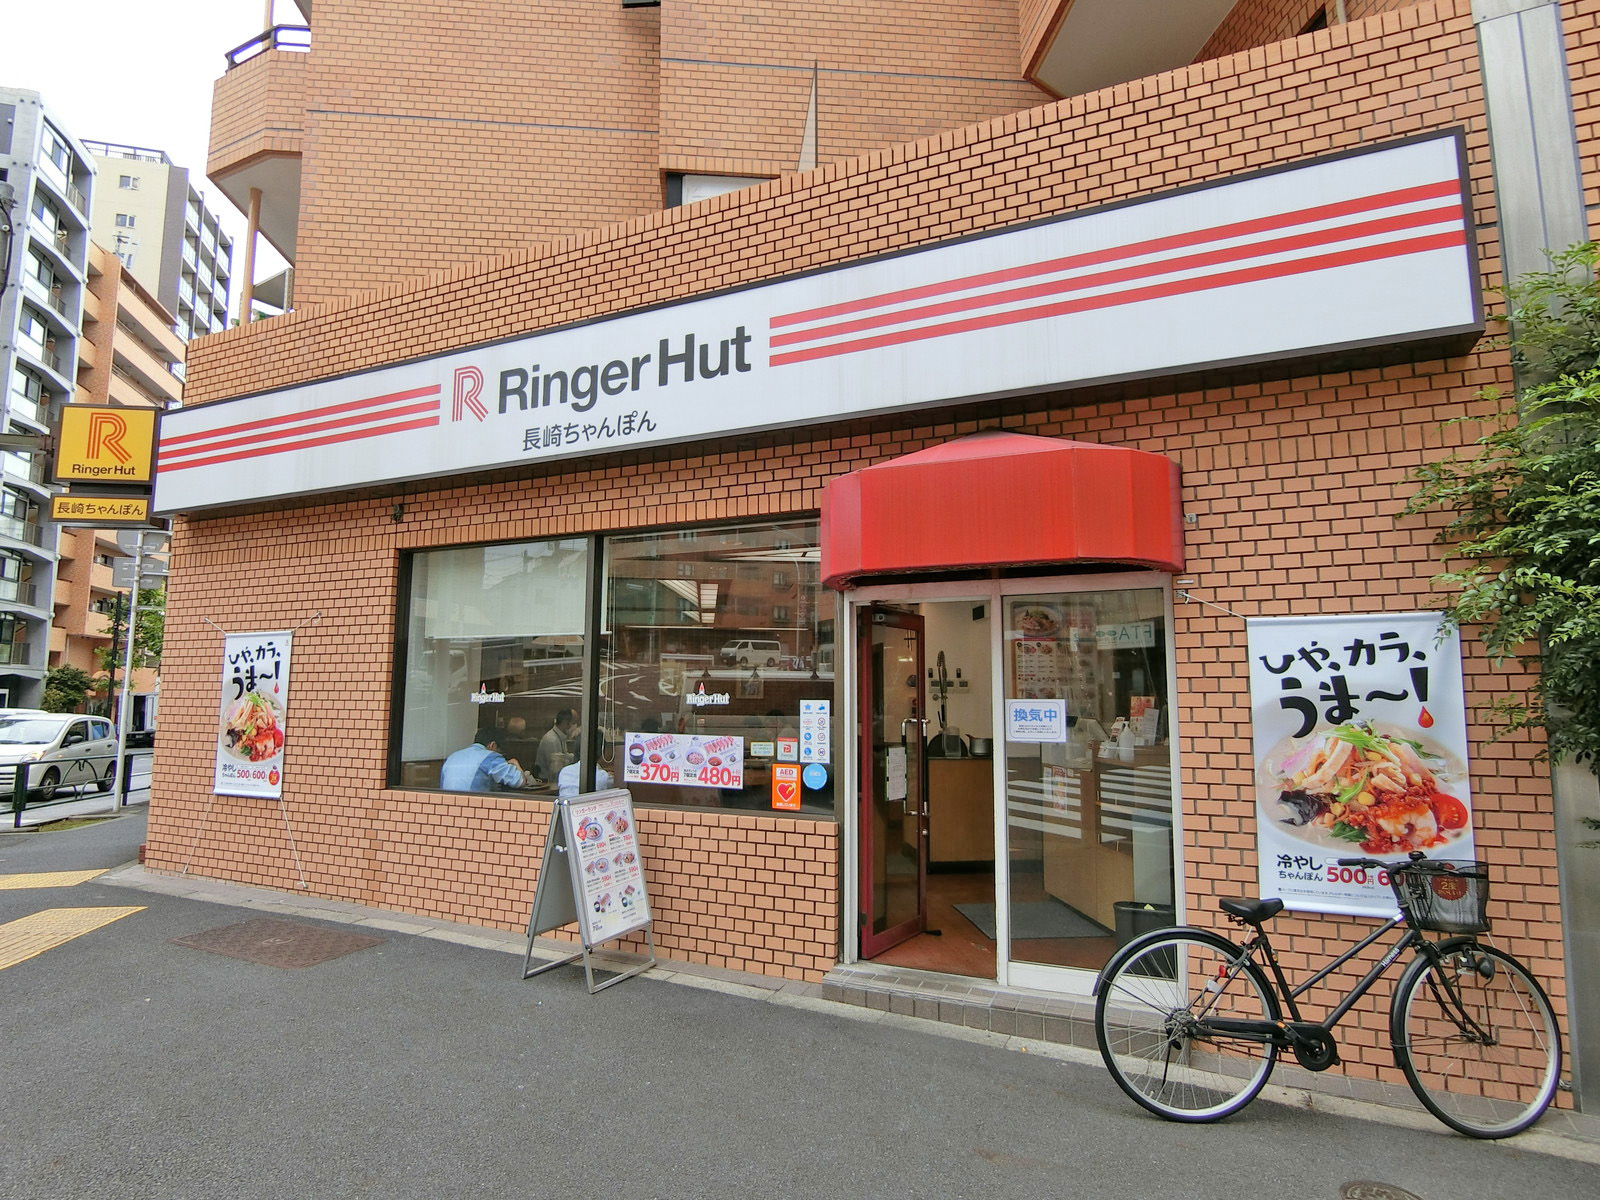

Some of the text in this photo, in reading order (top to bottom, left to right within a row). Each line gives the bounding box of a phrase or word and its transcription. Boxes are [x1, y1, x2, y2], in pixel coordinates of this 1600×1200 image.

[498, 326, 752, 413] Ringer Hut
[451, 365, 489, 423] R
[86, 412, 132, 464] R
[522, 410, 657, 451] 長崎ちゃんぽん
[71, 464, 136, 476] Ringer Hut
[57, 502, 144, 516] 長崎ちゃんぽん
[1013, 707, 1058, 722] 換気中
[1276, 854, 1323, 871] 冷やし
[1278, 869, 1324, 882] ちゃんぽん
